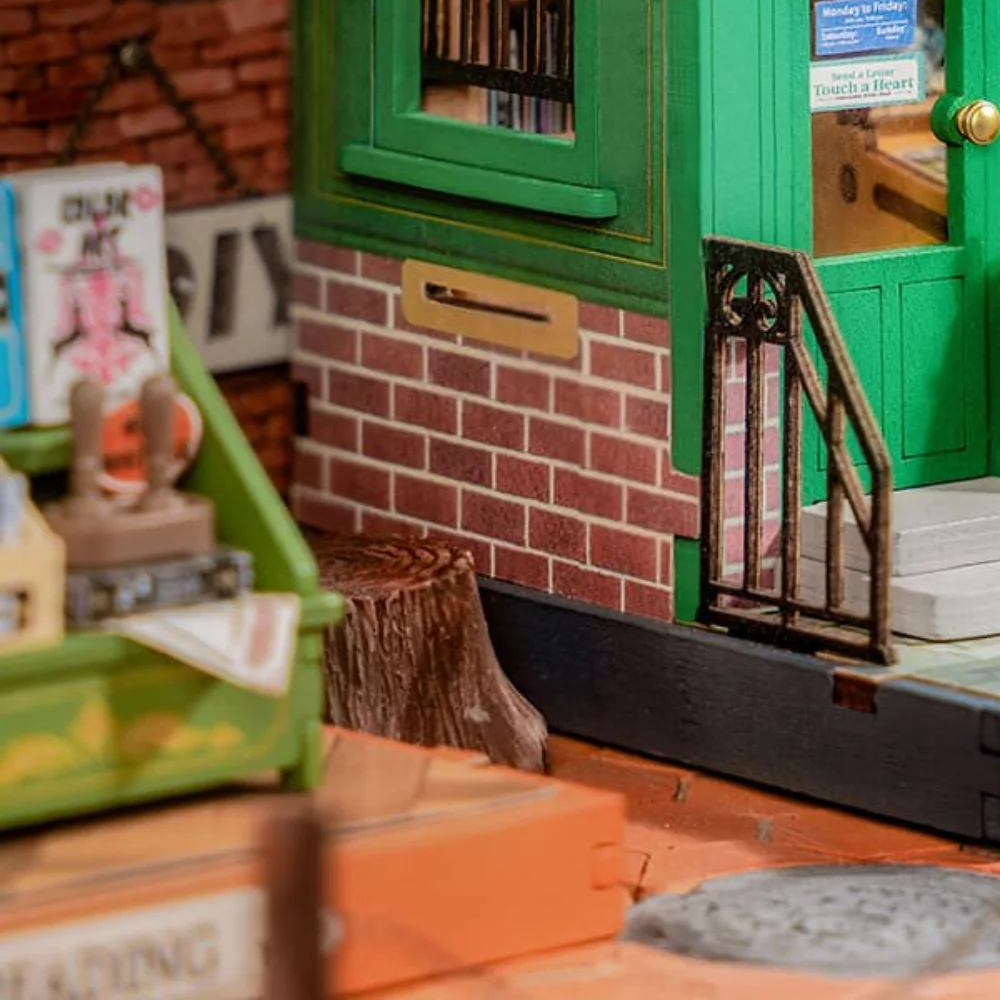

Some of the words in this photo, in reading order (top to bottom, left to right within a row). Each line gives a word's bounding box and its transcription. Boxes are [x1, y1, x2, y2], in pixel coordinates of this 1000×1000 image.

[823, 4, 859, 16] Monday
[861, 5, 871, 13] to
[814, 81, 857, 96] Touch
[860, 83, 869, 92] a
[873, 78, 914, 90] Heart
